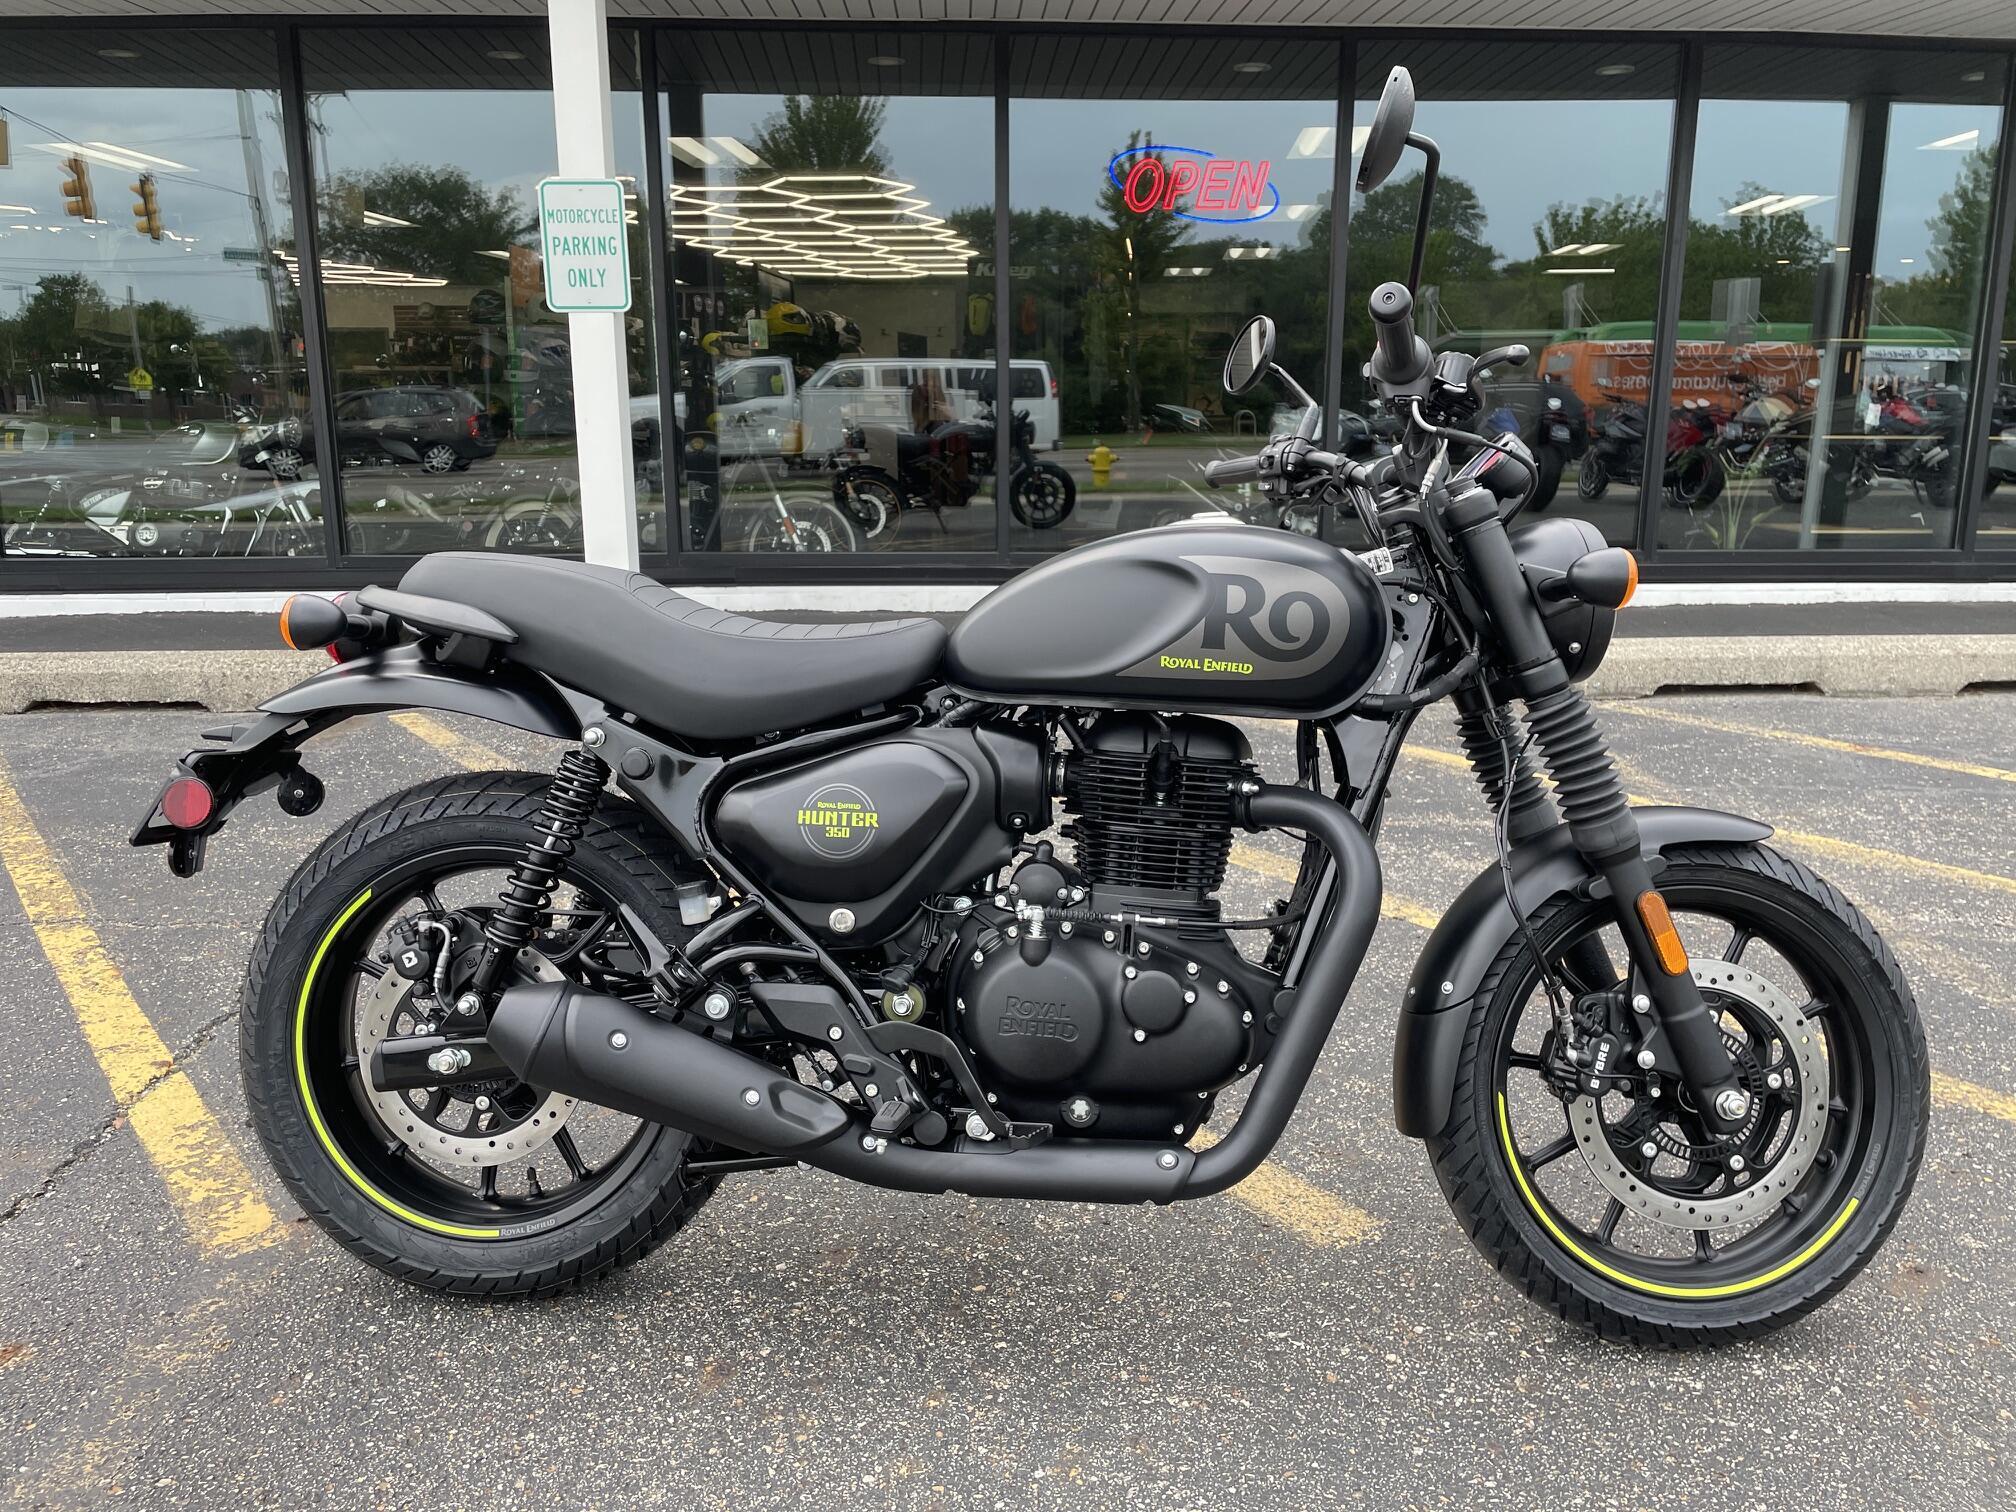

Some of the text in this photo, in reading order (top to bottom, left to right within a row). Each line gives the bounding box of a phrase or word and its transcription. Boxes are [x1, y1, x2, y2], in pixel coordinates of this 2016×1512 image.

[1124, 158, 1271, 214] OPEN
[547, 208, 619, 224] MOTORCYCLE
[552, 236, 617, 256] PARKING
[568, 268, 607, 288] ONLY
[1160, 655, 1253, 674] ROYAL ENFIELD
[817, 801, 861, 810] ROYAL ENFIELD
[797, 809, 879, 828] HUNTER
[825, 826, 850, 838] 350
[1005, 995, 1071, 1020] ROYAL
[998, 1017, 1080, 1042] ENFIELD
[1855, 1143, 1881, 1199] ROYAL ENFIELD
[500, 1218, 556, 1237] ROYAL ENFIELD
